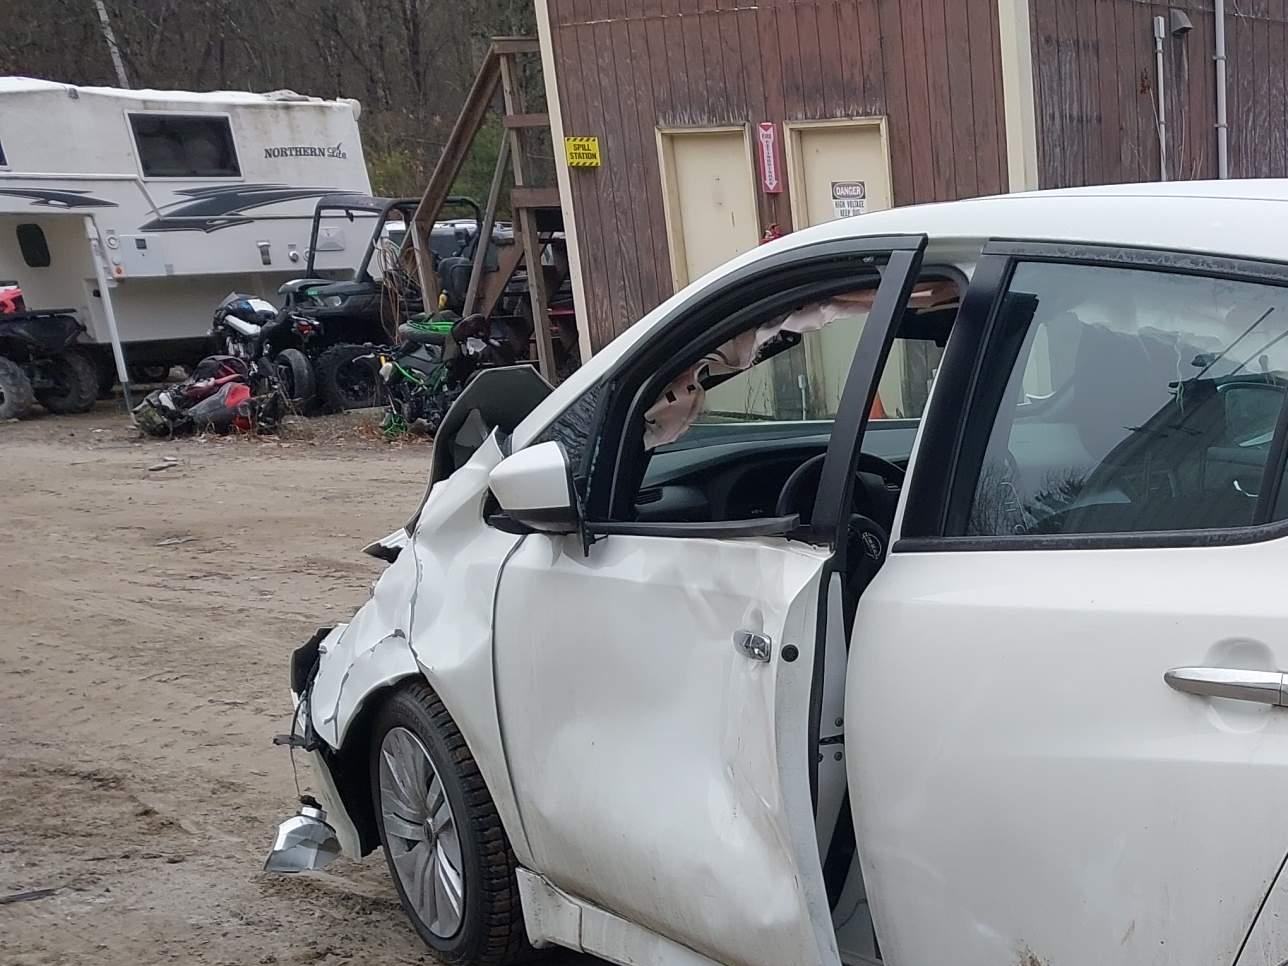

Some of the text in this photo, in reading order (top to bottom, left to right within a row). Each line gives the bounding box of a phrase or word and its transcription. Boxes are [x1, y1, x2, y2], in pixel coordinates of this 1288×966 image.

[573, 143, 592, 151] SPILL
[264, 146, 325, 159] NORTHERN
[569, 152, 597, 160] STATION
[835, 186, 861, 195] DANGER
